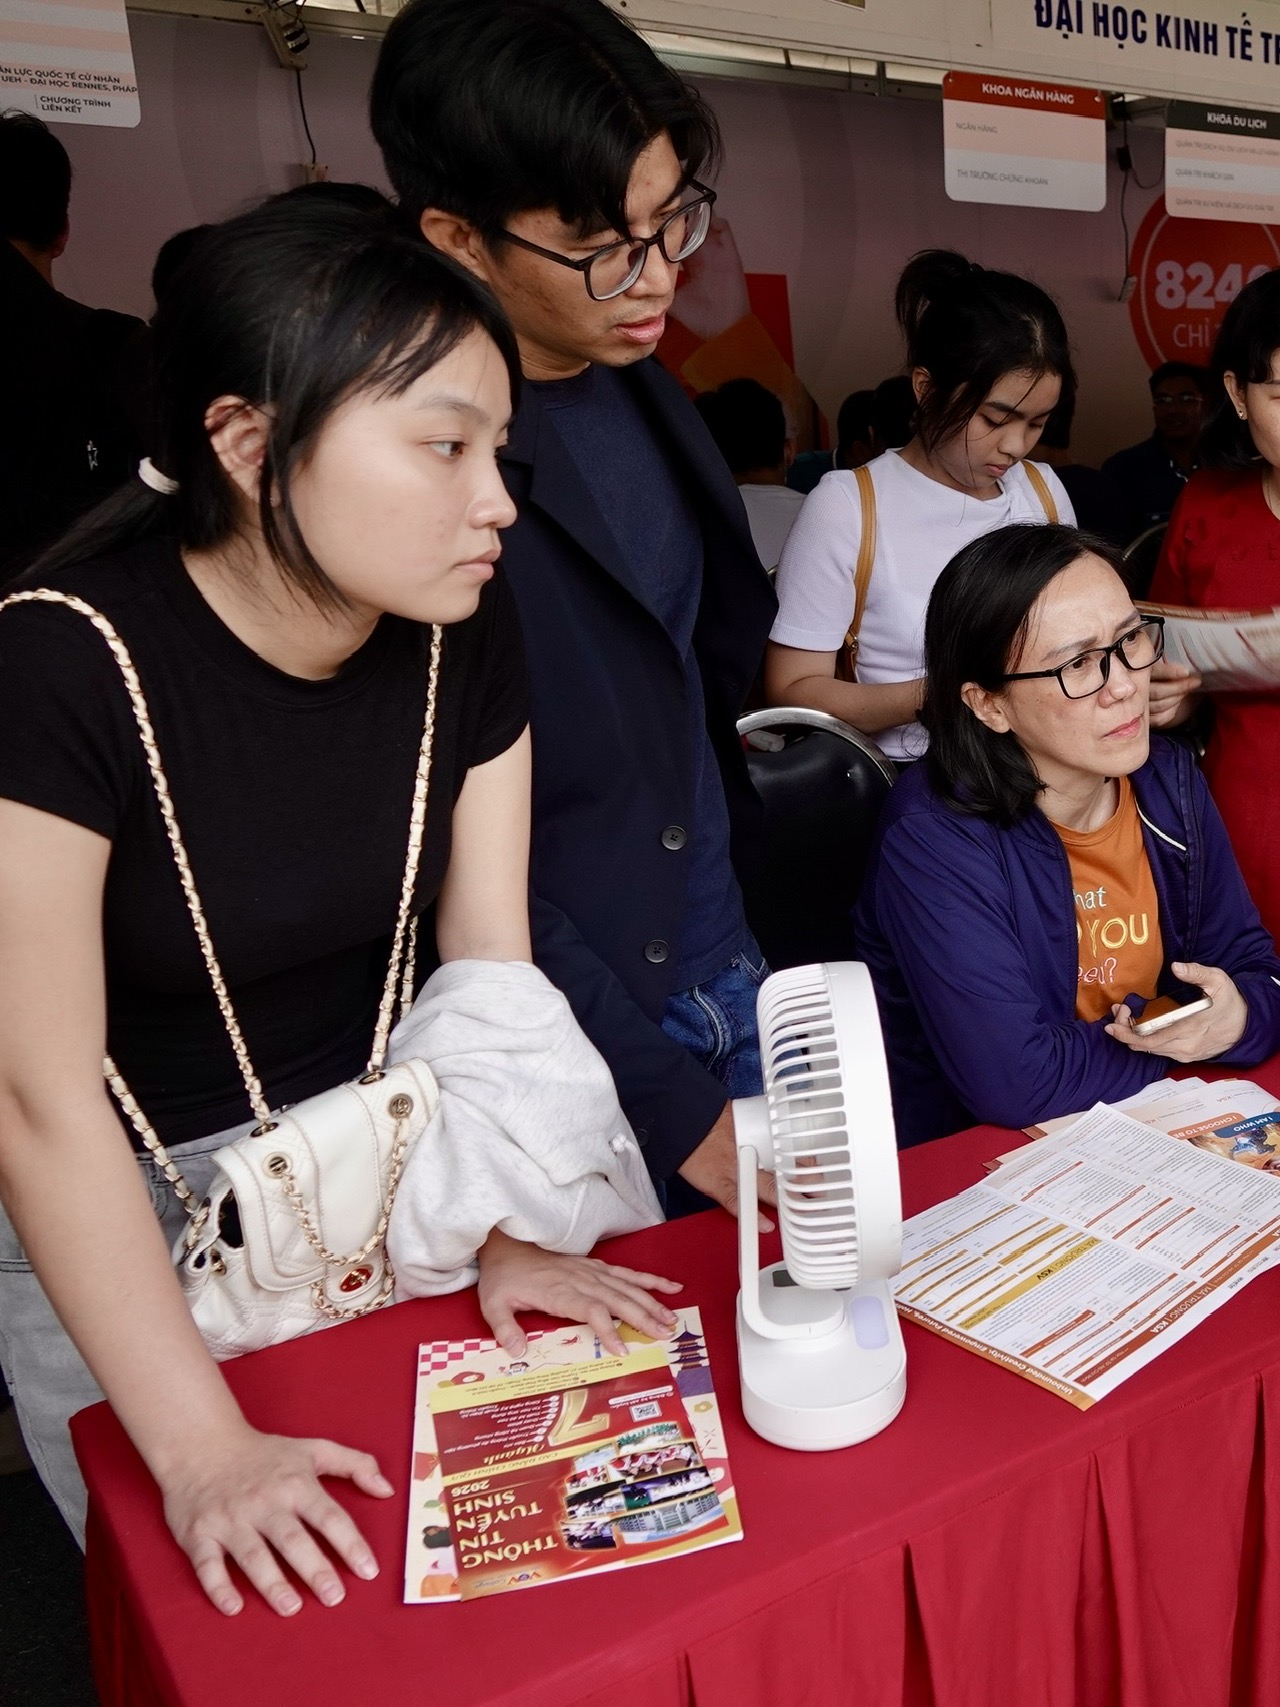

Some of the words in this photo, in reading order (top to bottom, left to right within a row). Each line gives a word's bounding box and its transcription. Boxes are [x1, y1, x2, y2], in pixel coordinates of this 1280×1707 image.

[1034, 0, 1083, 39] ĐẠI
[1092, 2, 1147, 49] HỌC
[1155, 13, 1218, 56] KINH
[1225, 12, 1253, 61] TẾ
[982, 83, 1013, 97] KHOA
[1014, 87, 1045, 101] NGÂN
[1046, 90, 1075, 104] HÀNG
[1155, 260, 1272, 309] 824
[1087, 913, 1149, 958] YOU
[1186, 1127, 1199, 1136] TO
[1199, 1116, 1232, 1132] CHOOSE
[1233, 1120, 1255, 1132] WHO
[1036, 1268, 1054, 1280] KSV
[943, 1326, 988, 1352] Empowered
[1150, 1319, 1169, 1334] KSA
[1025, 1367, 1073, 1396] Unbounded
[547, 1388, 610, 1447] 7
[451, 1479, 490, 1497] 2026
[453, 1489, 516, 1516] SINH
[456, 1501, 543, 1533] TUYỂN
[459, 1530, 505, 1552] TIN
[461, 1535, 559, 1569] THÔNG
